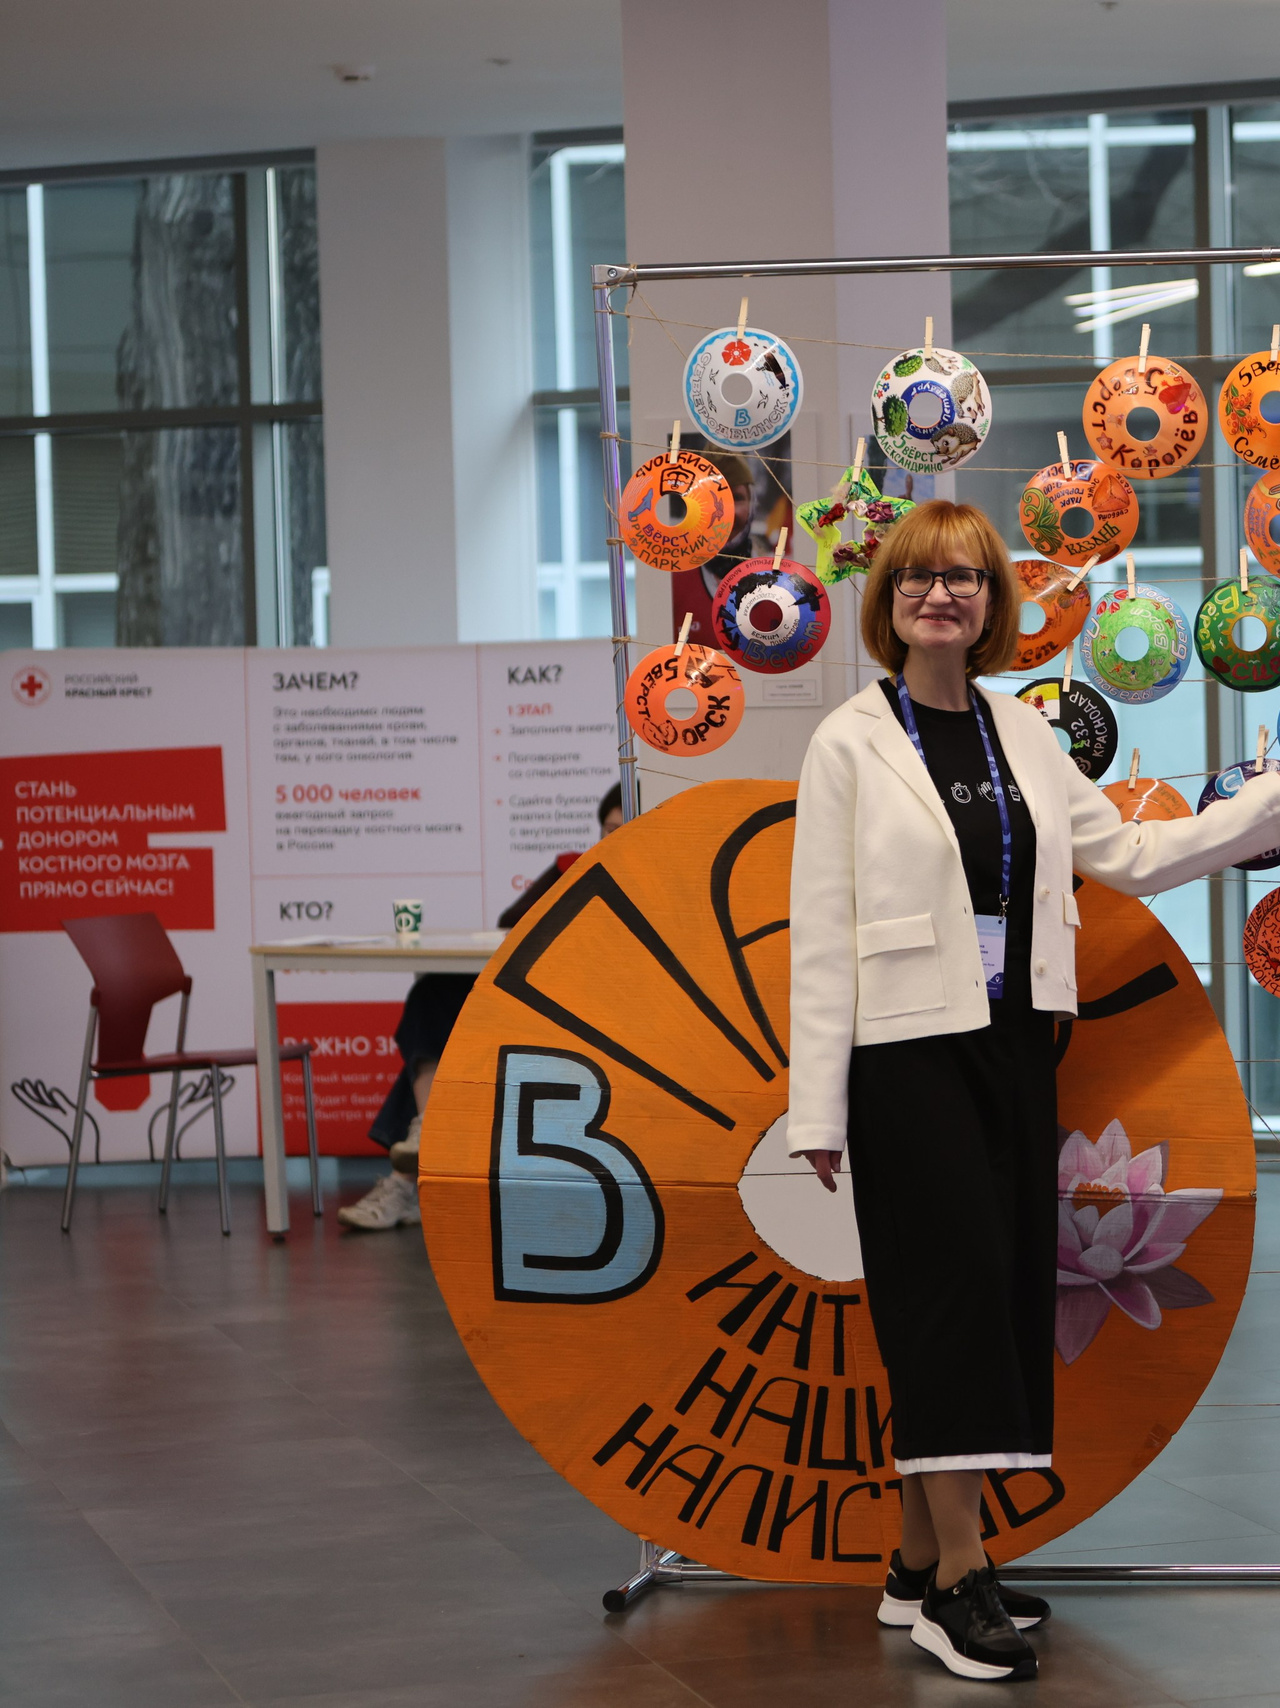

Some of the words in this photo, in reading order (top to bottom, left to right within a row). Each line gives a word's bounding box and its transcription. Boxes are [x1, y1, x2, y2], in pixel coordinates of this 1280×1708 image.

[638, 550, 682, 570] ПАРК
[273, 672, 359, 691] ЗАЧЕМ?
[508, 666, 562, 684] КАК?
[122, 686, 152, 697] КРЕСТ
[517, 704, 552, 716] ЭТАП
[1069, 690, 1108, 758] КРАСНОДАР
[15, 781, 76, 798] СТАНЬ
[276, 786, 288, 802] 5
[292, 784, 334, 802] 000
[339, 786, 421, 801] человек
[16, 802, 194, 823] ПОТЕНЦИАЛЬНЫМ
[17, 829, 118, 850] ДОНОРОМ
[18, 854, 121, 874] КОСТНОГО
[126, 852, 190, 870] МОЗГА
[19, 880, 87, 898] ПРЯМО
[91, 877, 174, 896] СЕЙЧАС!
[280, 902, 333, 921] КТО?
